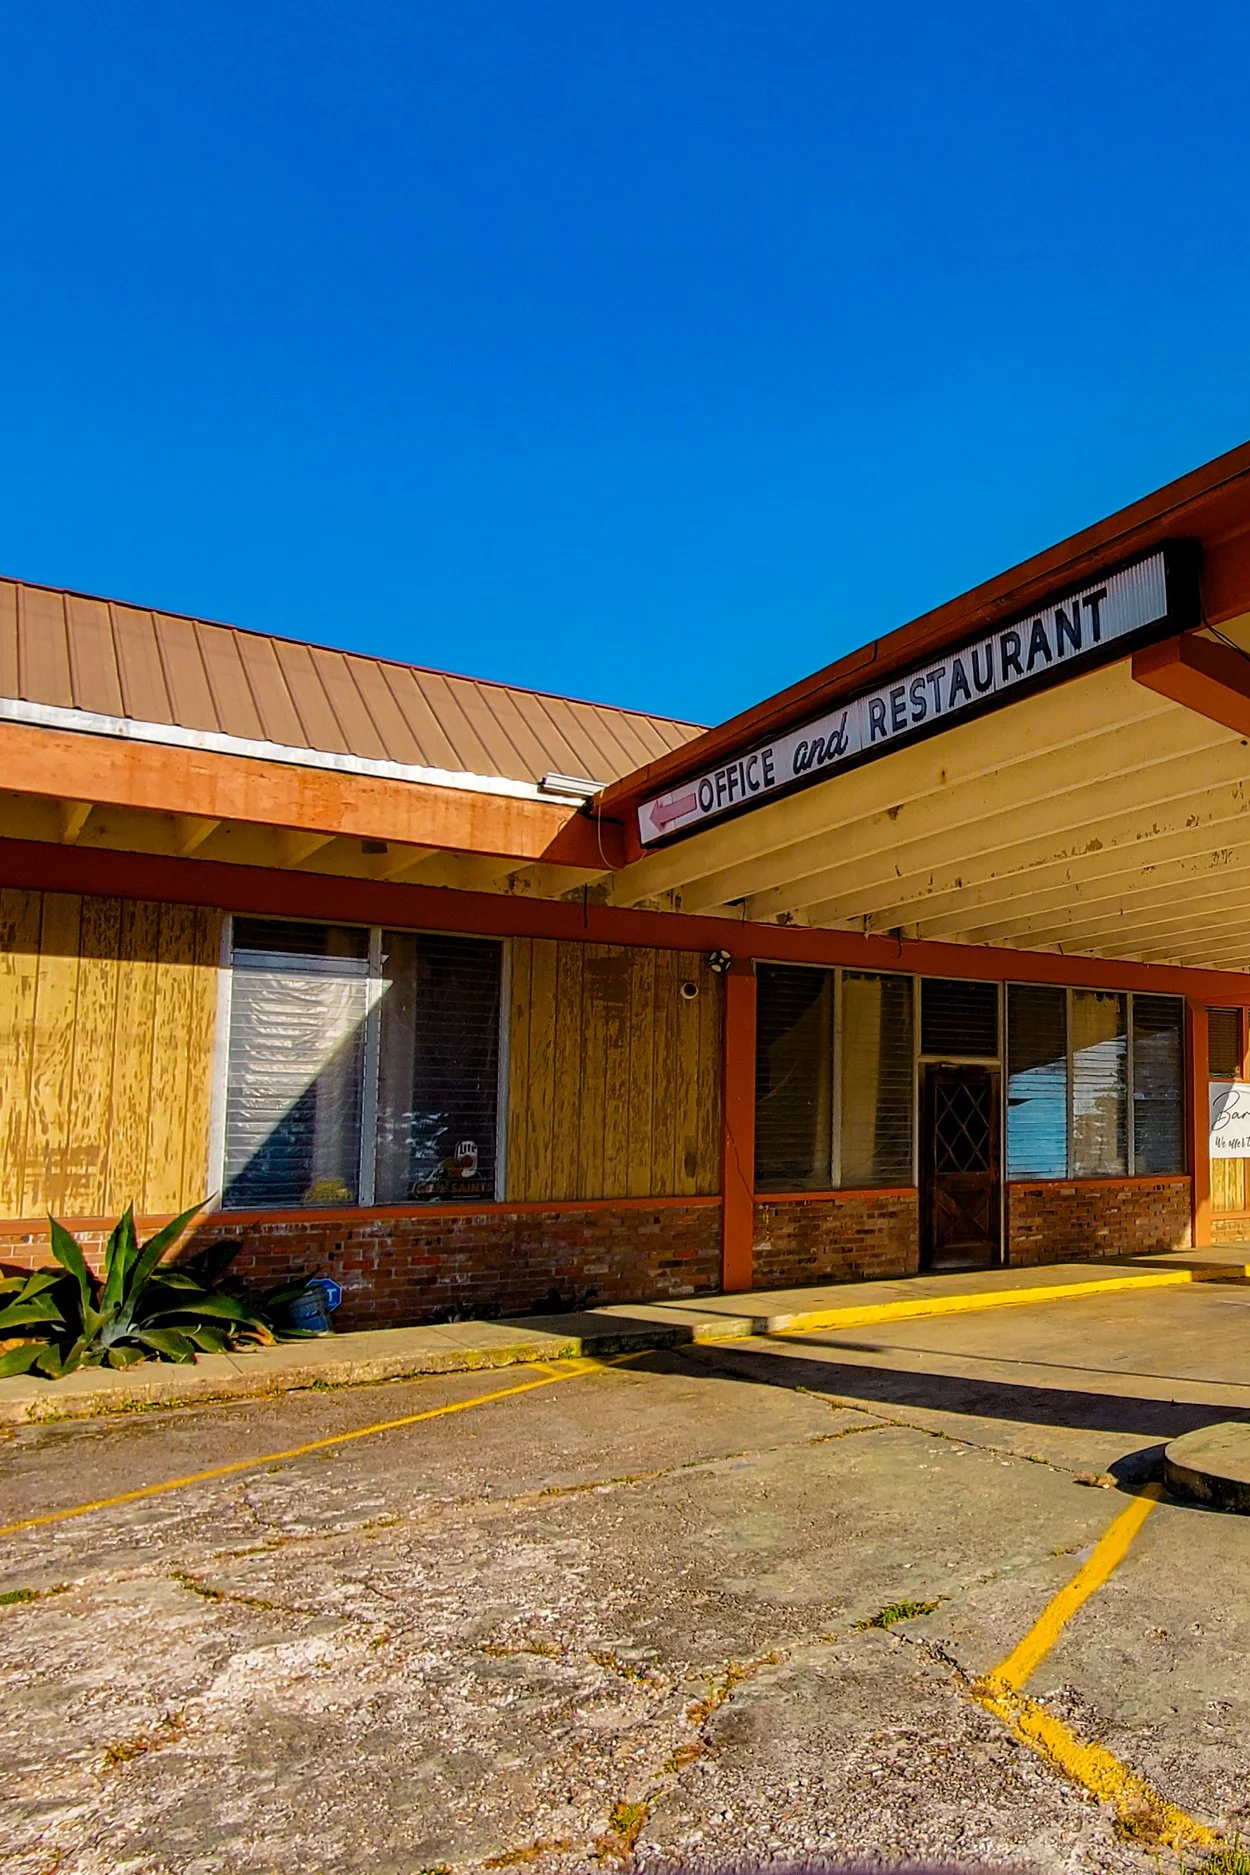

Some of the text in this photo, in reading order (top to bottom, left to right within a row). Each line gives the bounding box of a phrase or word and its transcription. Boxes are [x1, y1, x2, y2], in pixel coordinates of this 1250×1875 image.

[698, 587, 1108, 813] OFFICE and RESTAURANT
[1215, 1136, 1226, 1148] We
